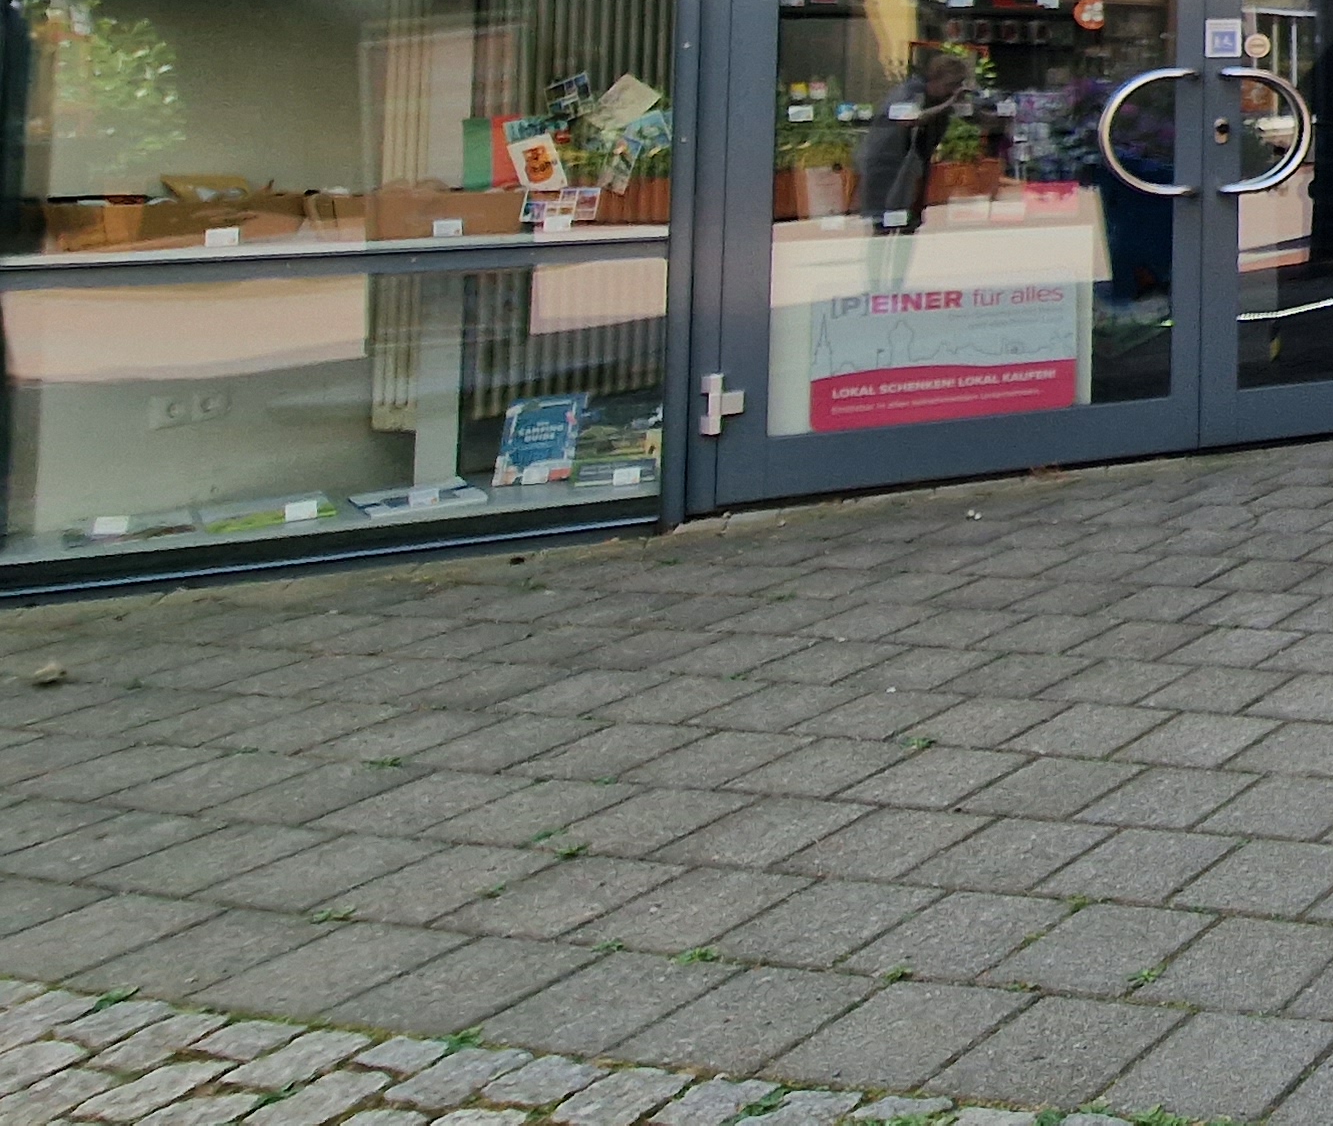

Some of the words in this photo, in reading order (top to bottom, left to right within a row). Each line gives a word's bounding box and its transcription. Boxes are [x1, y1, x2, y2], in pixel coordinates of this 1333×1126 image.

[831, 289, 964, 320] [P]EINER
[972, 287, 1003, 308] für
[1010, 283, 1065, 305] alles
[832, 385, 876, 400] LOKAL
[879, 377, 956, 395] SCHENKEN!
[958, 374, 999, 389] LOKAL
[1002, 368, 1057, 384] KAUFEN!
